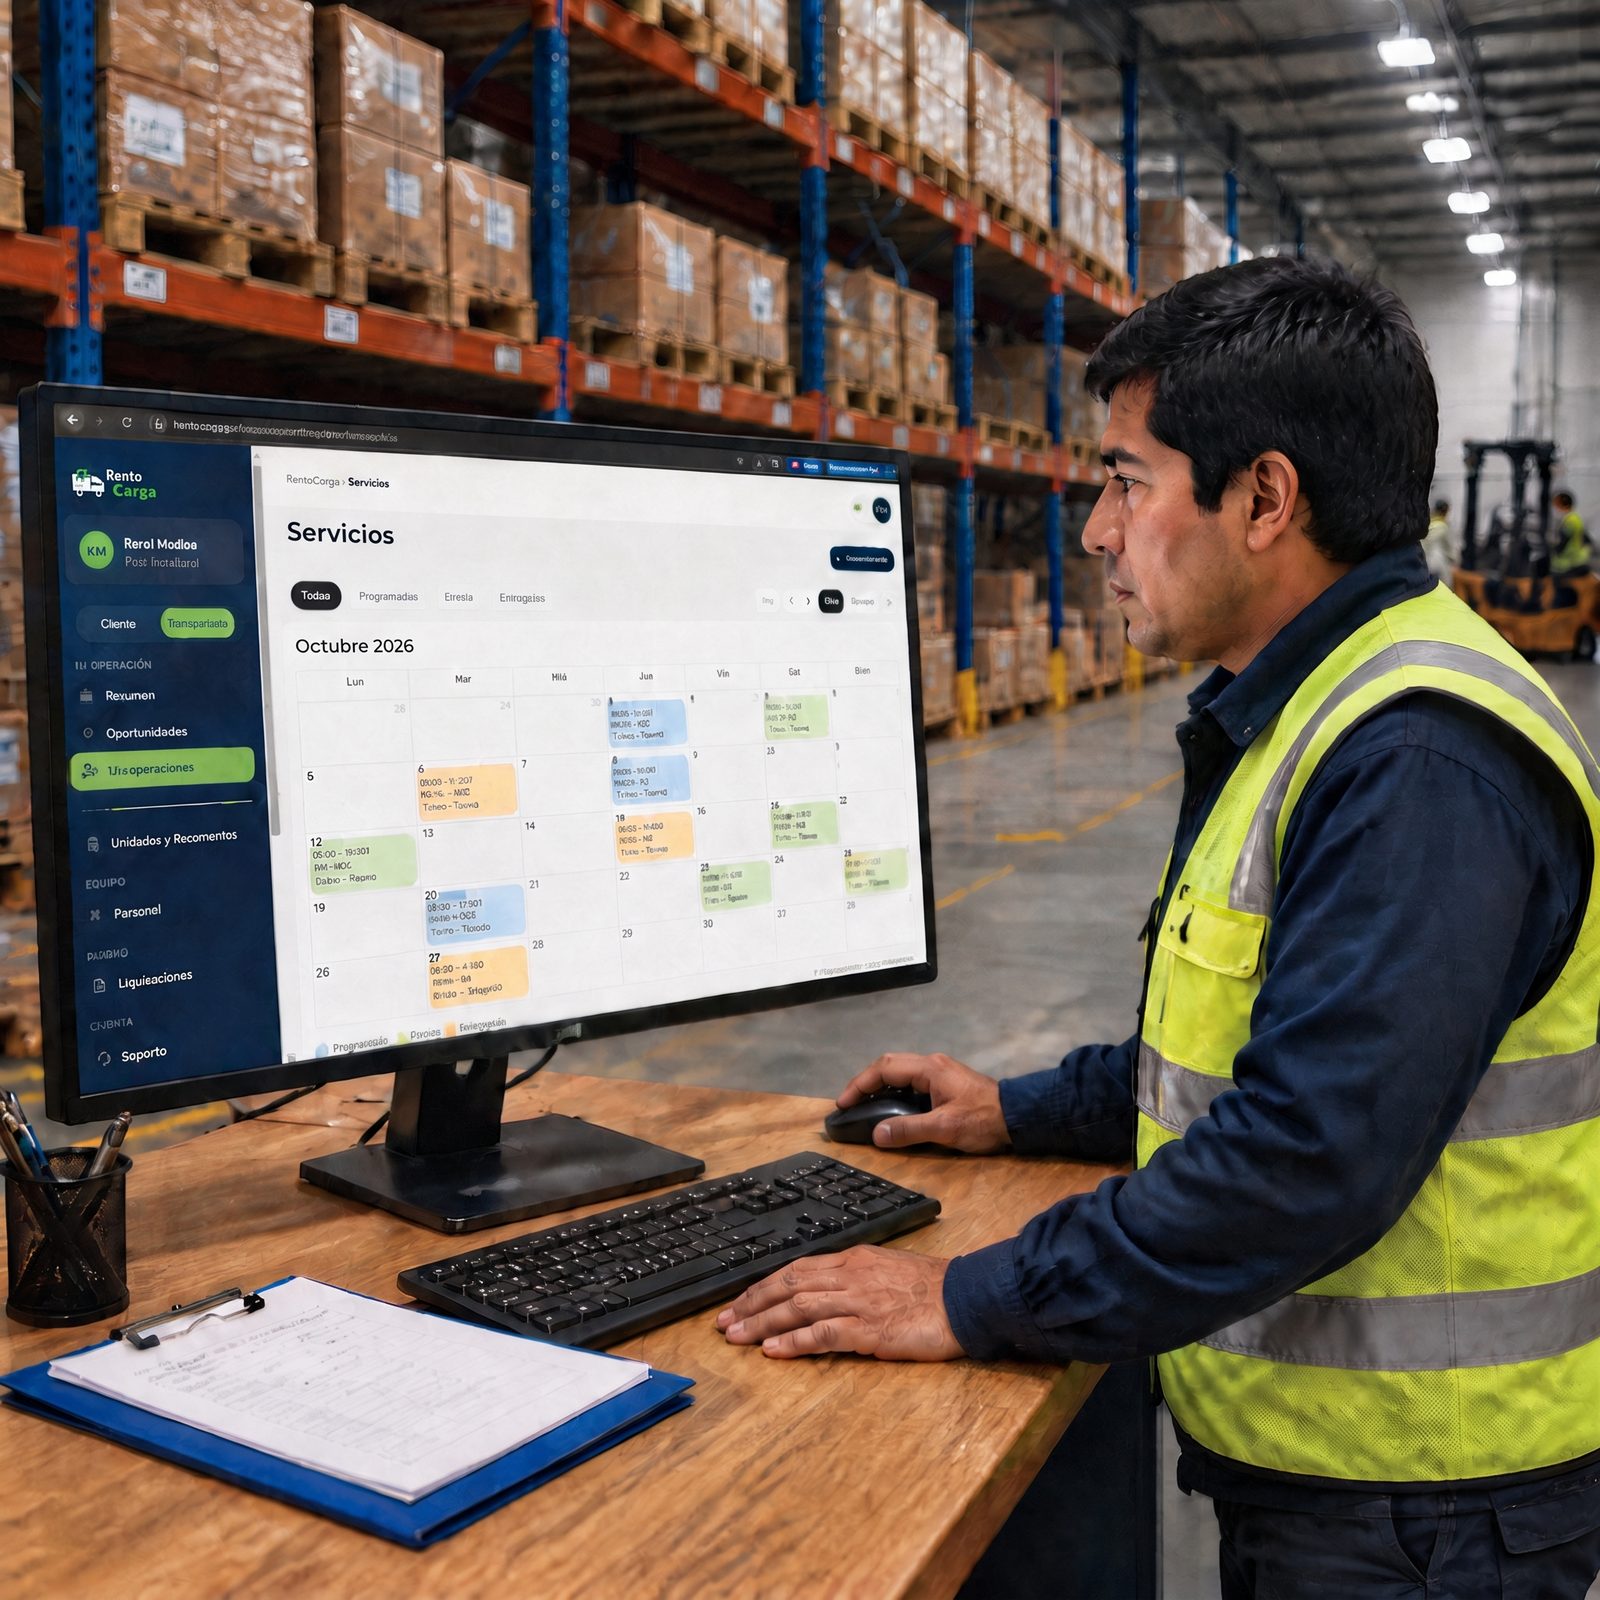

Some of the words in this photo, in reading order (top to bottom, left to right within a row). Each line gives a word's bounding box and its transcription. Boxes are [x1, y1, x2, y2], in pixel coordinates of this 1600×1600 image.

[106, 469, 143, 482] Rento
[348, 477, 390, 489] Servicios
[112, 484, 157, 501] Carga
[287, 521, 394, 545] Servicios
[87, 546, 107, 556] KM
[100, 618, 137, 629] Cliente
[295, 638, 369, 654] Octubre
[373, 638, 414, 654] 2026
[455, 674, 472, 684] Mar
[639, 672, 654, 681] Jun
[716, 669, 730, 678] Vin
[346, 676, 364, 687] Lun
[106, 726, 188, 741] Oportunidades
[693, 750, 698, 759] 9
[417, 764, 425, 774] 6
[521, 759, 527, 769] 7
[129, 762, 194, 778] operaciones
[306, 771, 314, 782] 5
[525, 821, 536, 831] 14
[422, 829, 434, 839] 13
[164, 837, 171, 848] y
[310, 836, 323, 848] 12
[774, 855, 784, 864] 24
[619, 871, 630, 881] 22
[85, 877, 126, 890] EQUIPO
[529, 880, 539, 890] 21
[424, 890, 437, 901] 20
[313, 903, 326, 914] 19
[703, 919, 714, 929] 30
[622, 928, 633, 938] 29
[532, 940, 544, 950] 28
[428, 953, 441, 964] 27
[315, 967, 330, 979] 26
